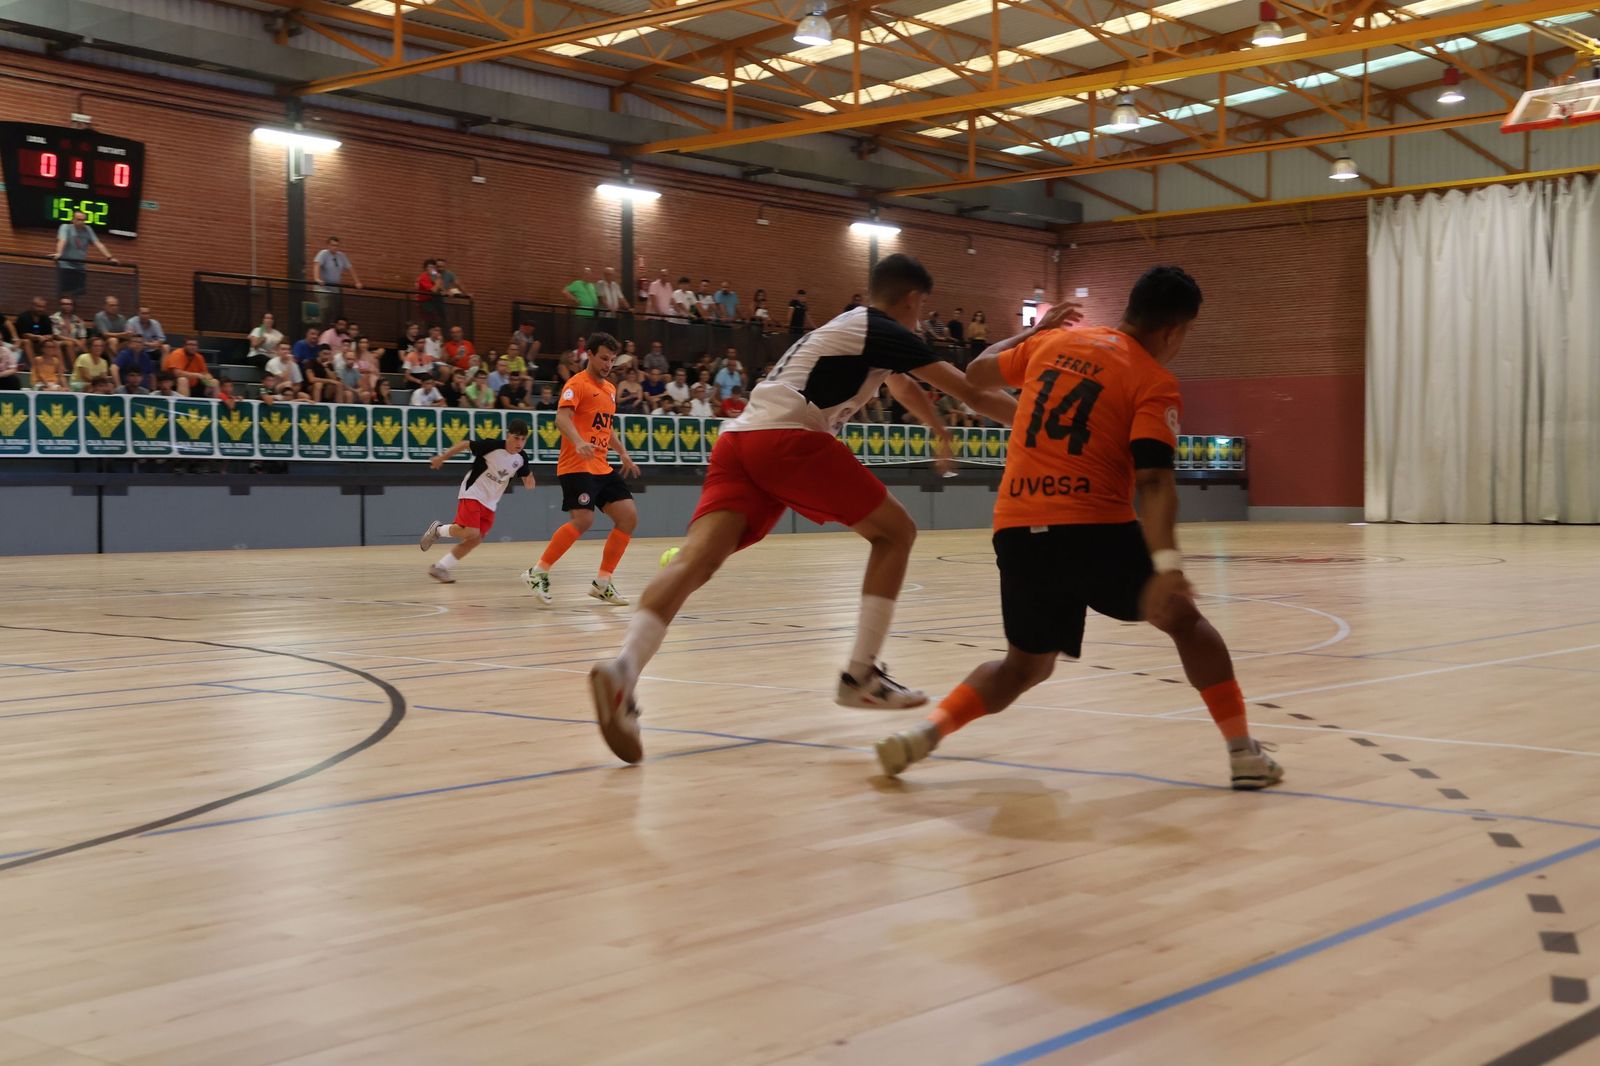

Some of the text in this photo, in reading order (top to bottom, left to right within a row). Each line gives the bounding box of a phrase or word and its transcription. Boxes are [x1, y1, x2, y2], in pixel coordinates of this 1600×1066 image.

[41, 153, 57, 178] 0
[75, 161, 83, 178] 1
[114, 163, 130, 187] 0
[1025, 368, 1105, 456] 14
[1009, 475, 1091, 498] uvesa
